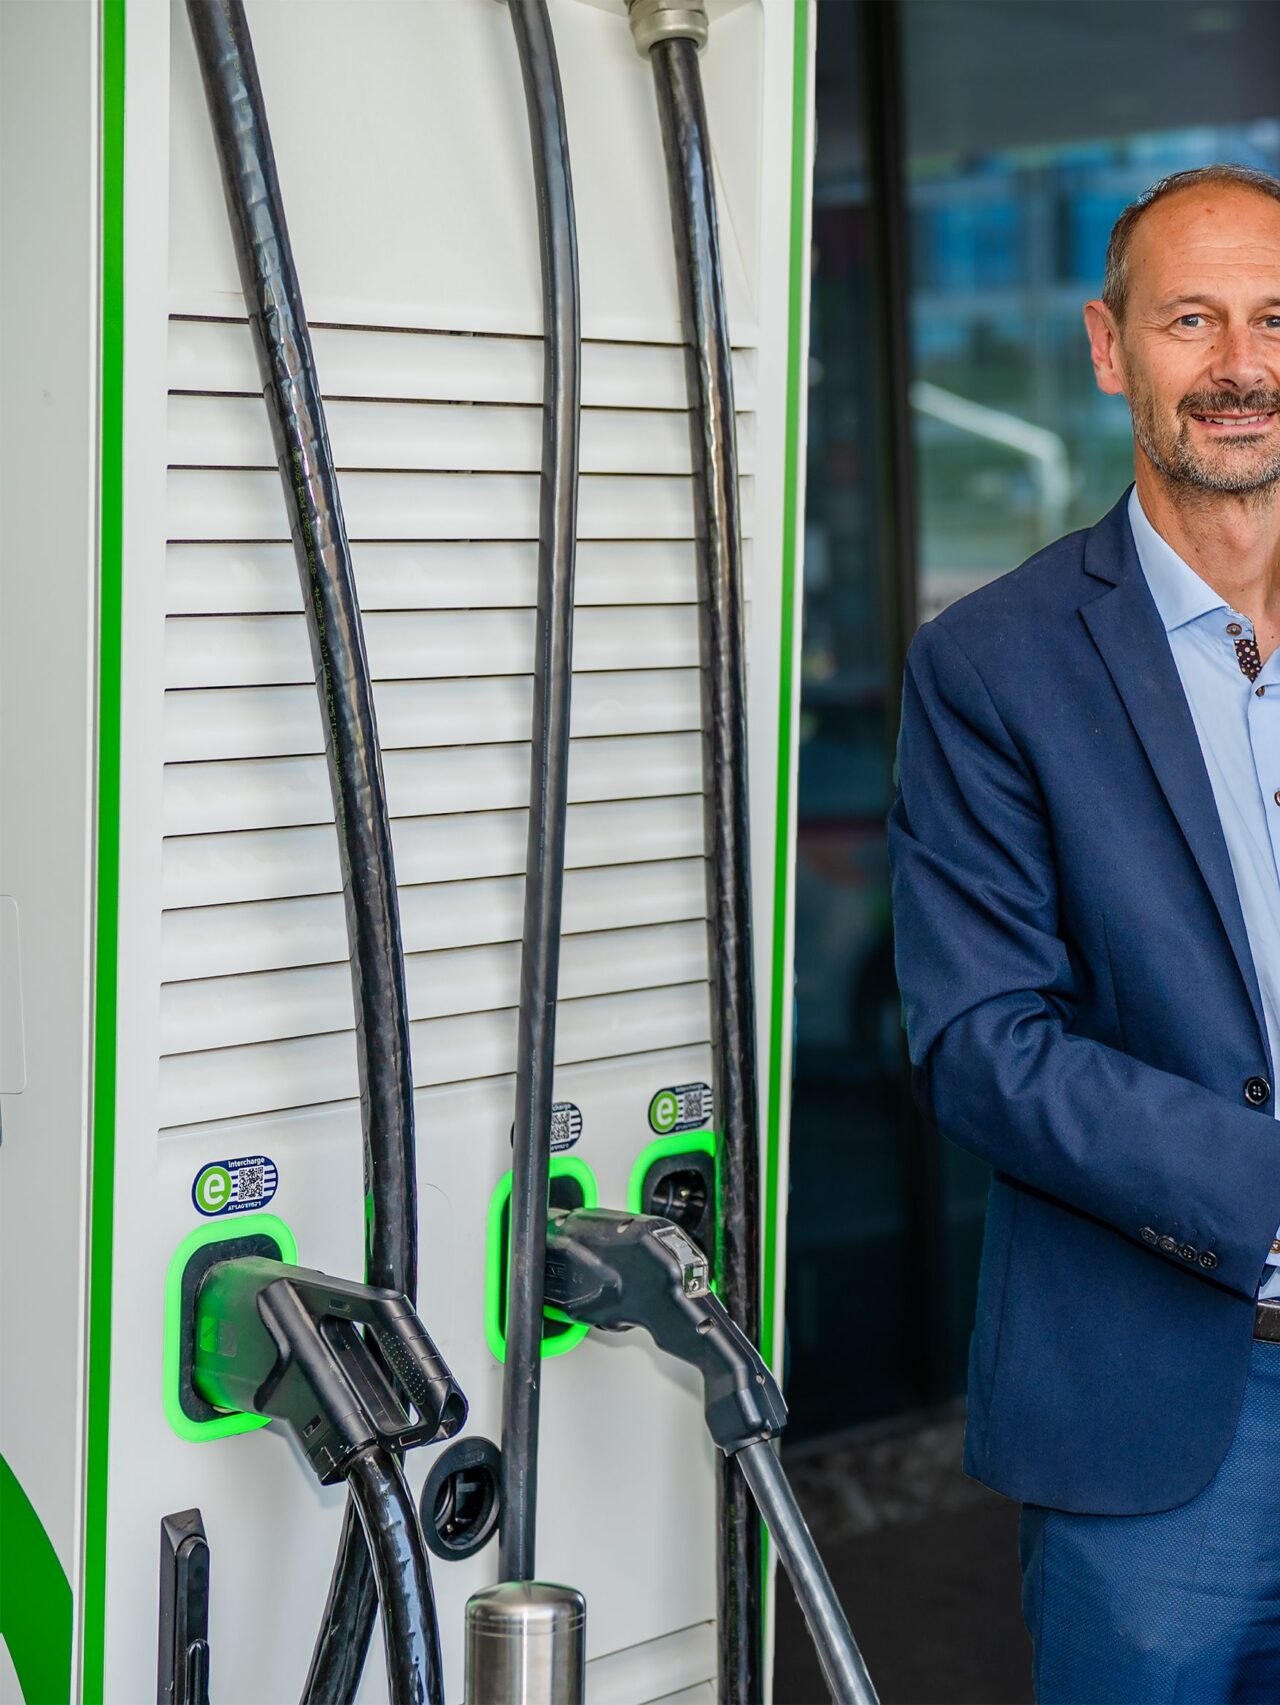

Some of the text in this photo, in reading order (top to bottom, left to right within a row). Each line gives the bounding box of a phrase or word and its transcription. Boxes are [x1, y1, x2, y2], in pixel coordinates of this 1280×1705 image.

[656, 1097, 674, 1126] e
[228, 1157, 265, 1168] intercharge
[203, 1173, 225, 1205] e
